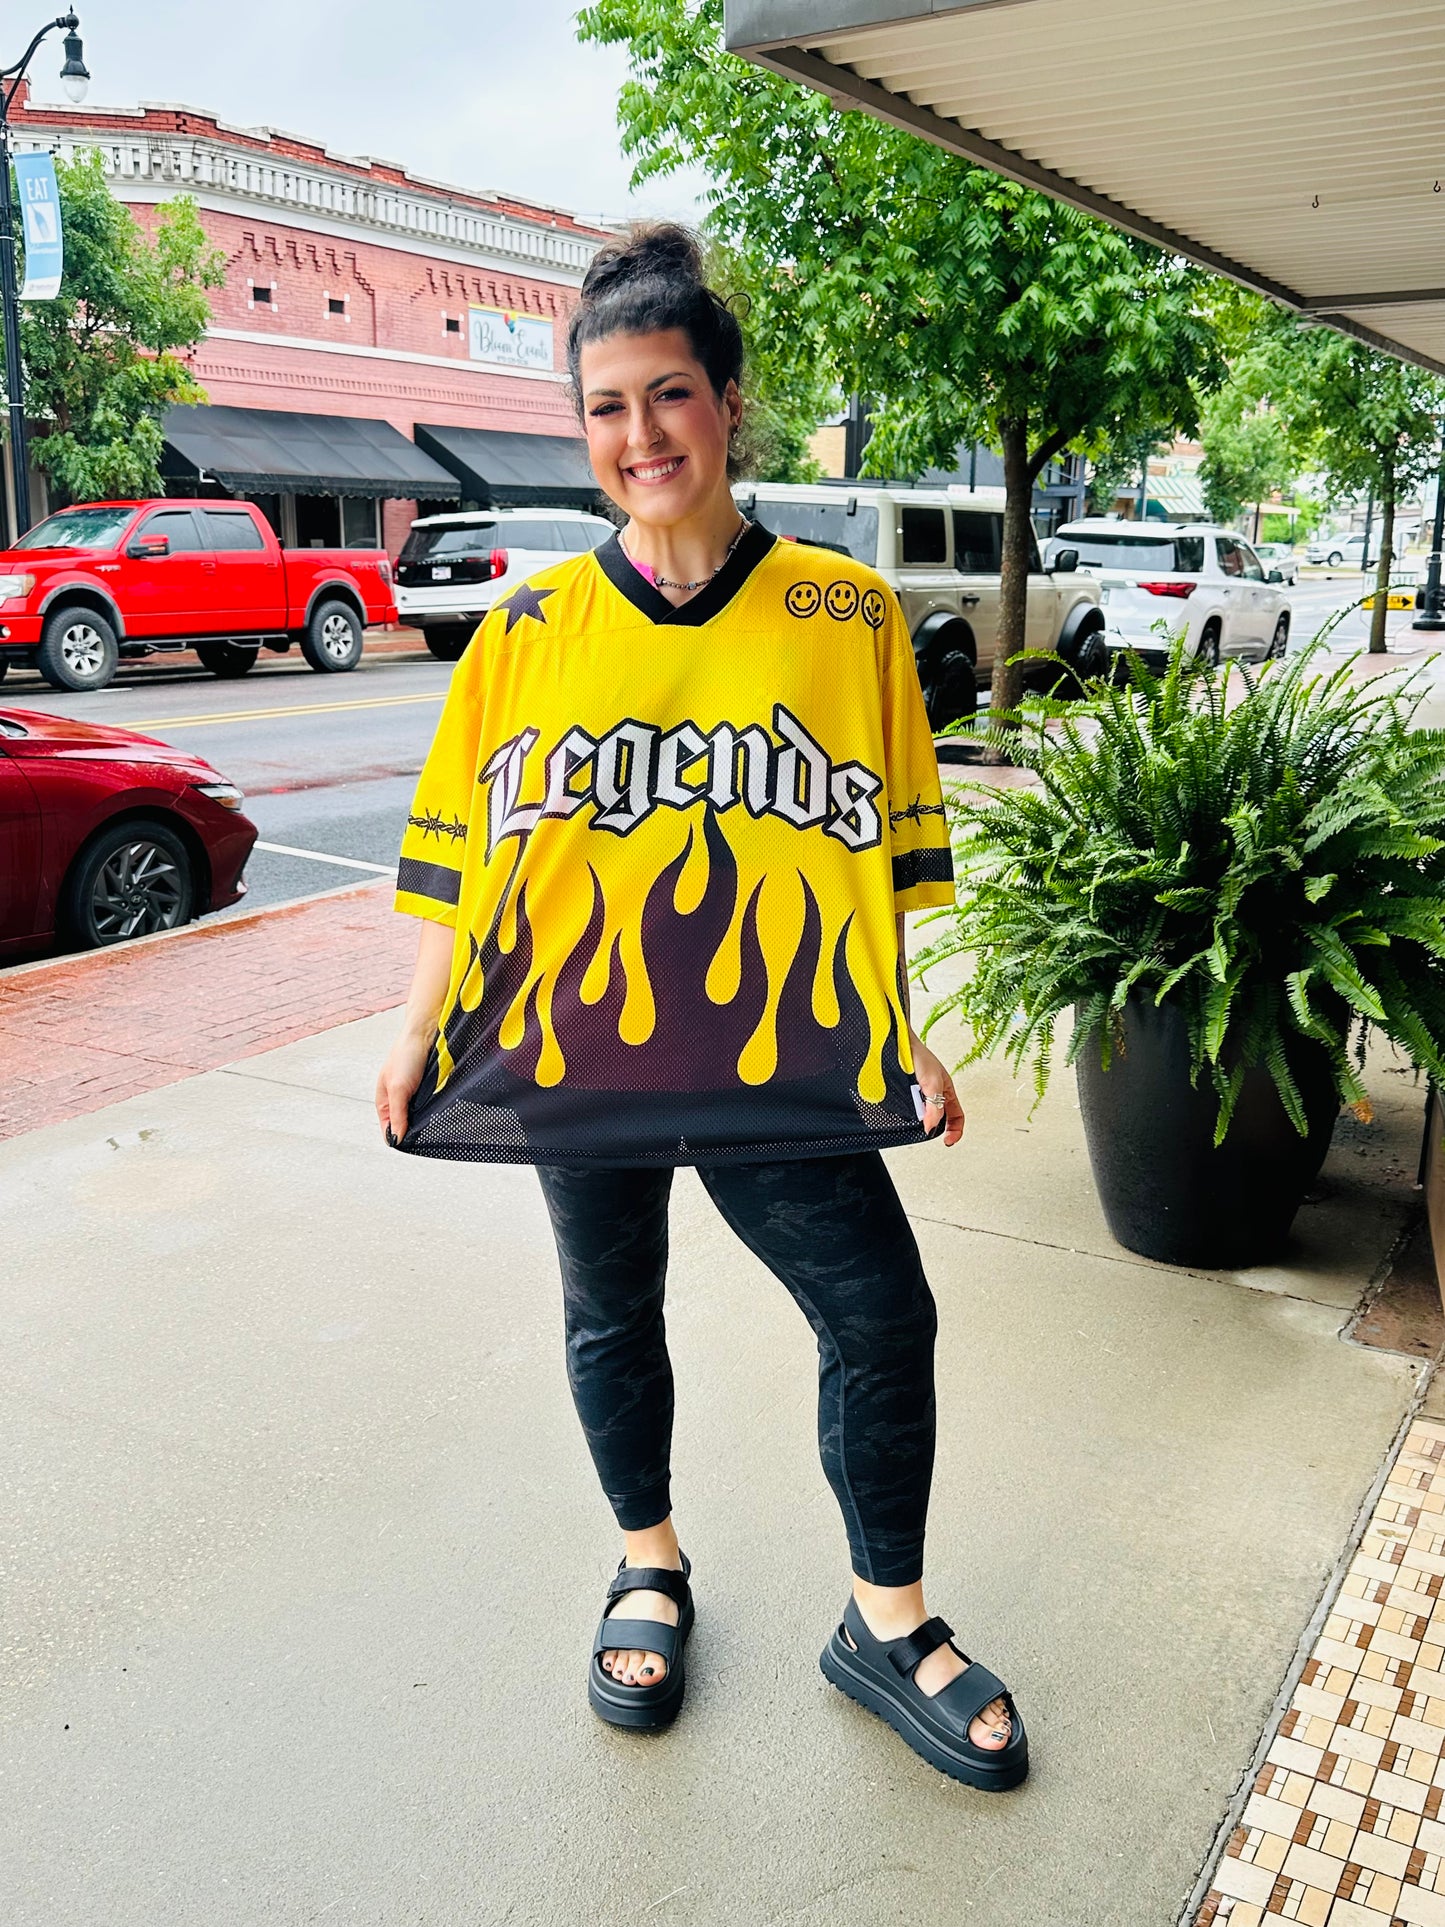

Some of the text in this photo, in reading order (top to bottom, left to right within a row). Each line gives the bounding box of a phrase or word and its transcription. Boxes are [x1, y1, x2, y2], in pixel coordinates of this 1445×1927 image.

[26, 178, 48, 200] EAT
[474, 320, 512, 353] Bloom
[479, 703, 883, 866] Legends
